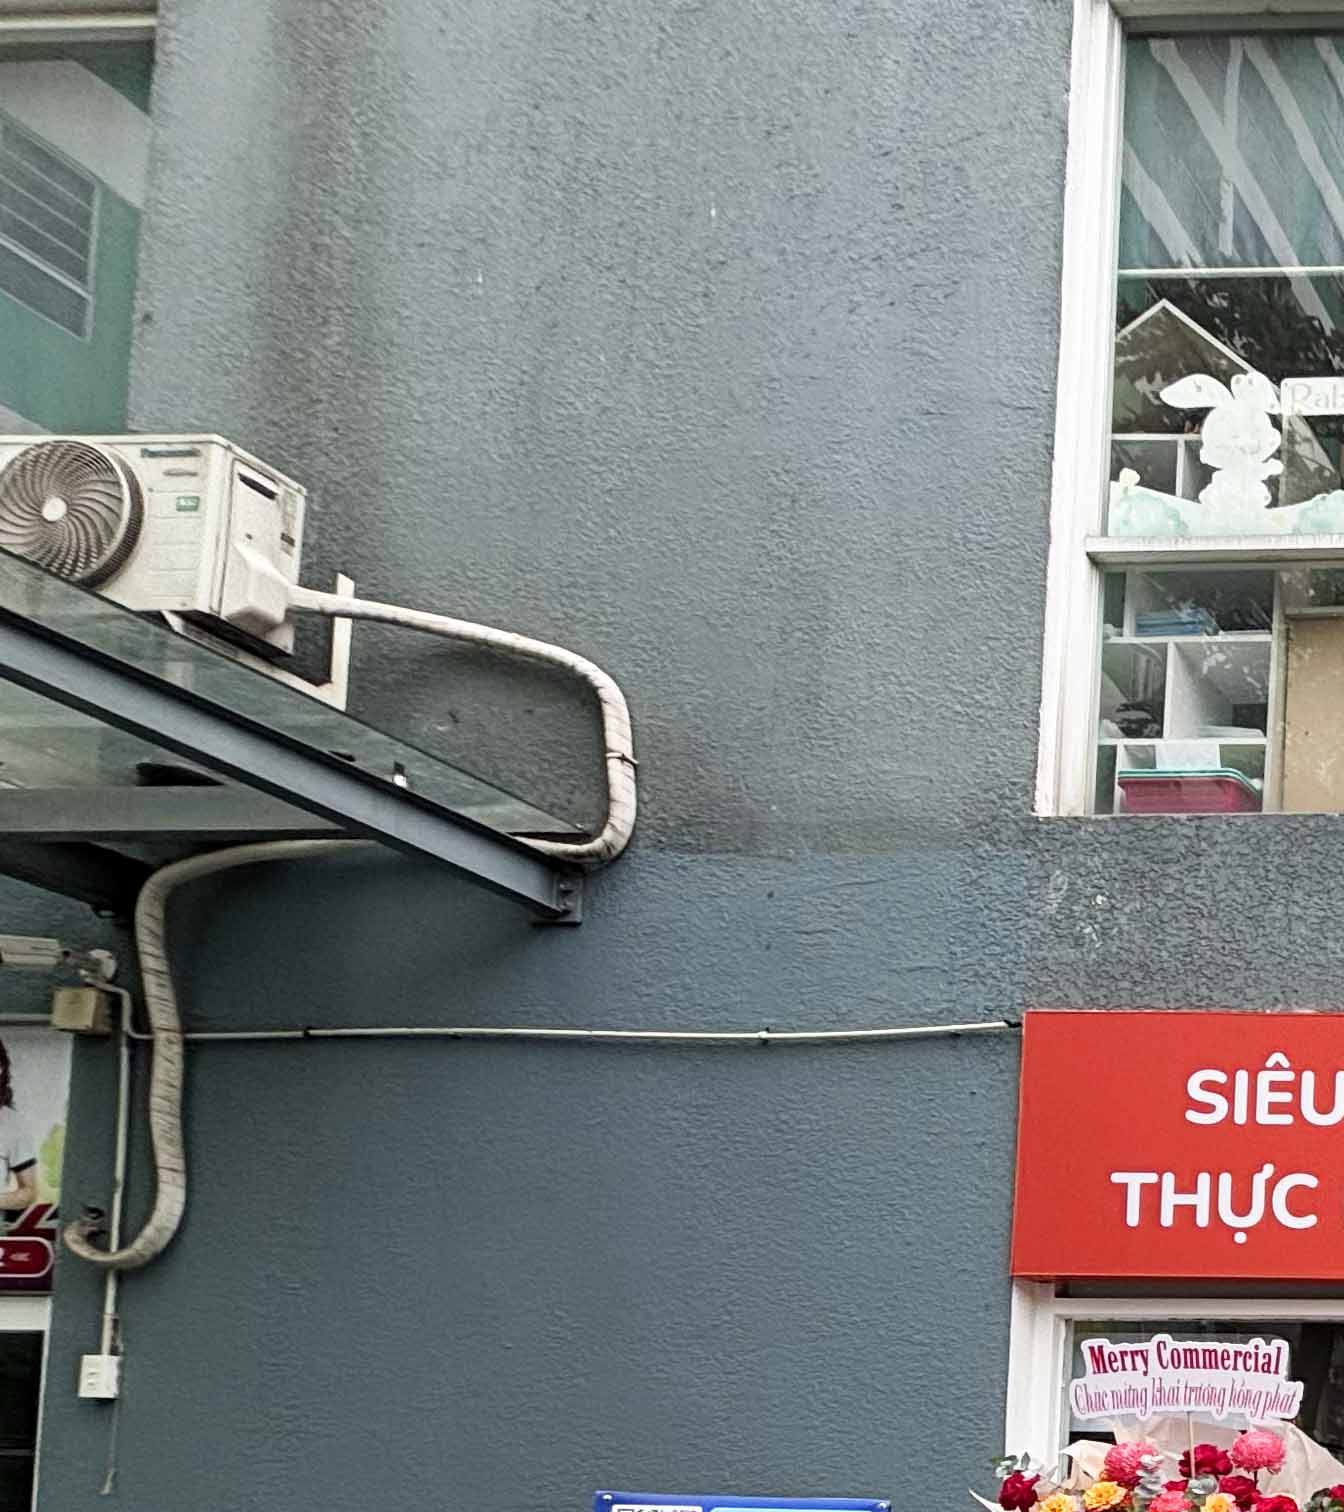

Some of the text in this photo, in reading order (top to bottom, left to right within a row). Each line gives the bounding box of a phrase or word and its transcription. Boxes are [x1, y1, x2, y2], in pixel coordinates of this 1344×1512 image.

[1109, 1162, 1319, 1244] THỰC
[1087, 1340, 1283, 1376] Merry Commercial
[1073, 1383, 1108, 1415] Chúc
[1151, 1376, 1181, 1407] khai
